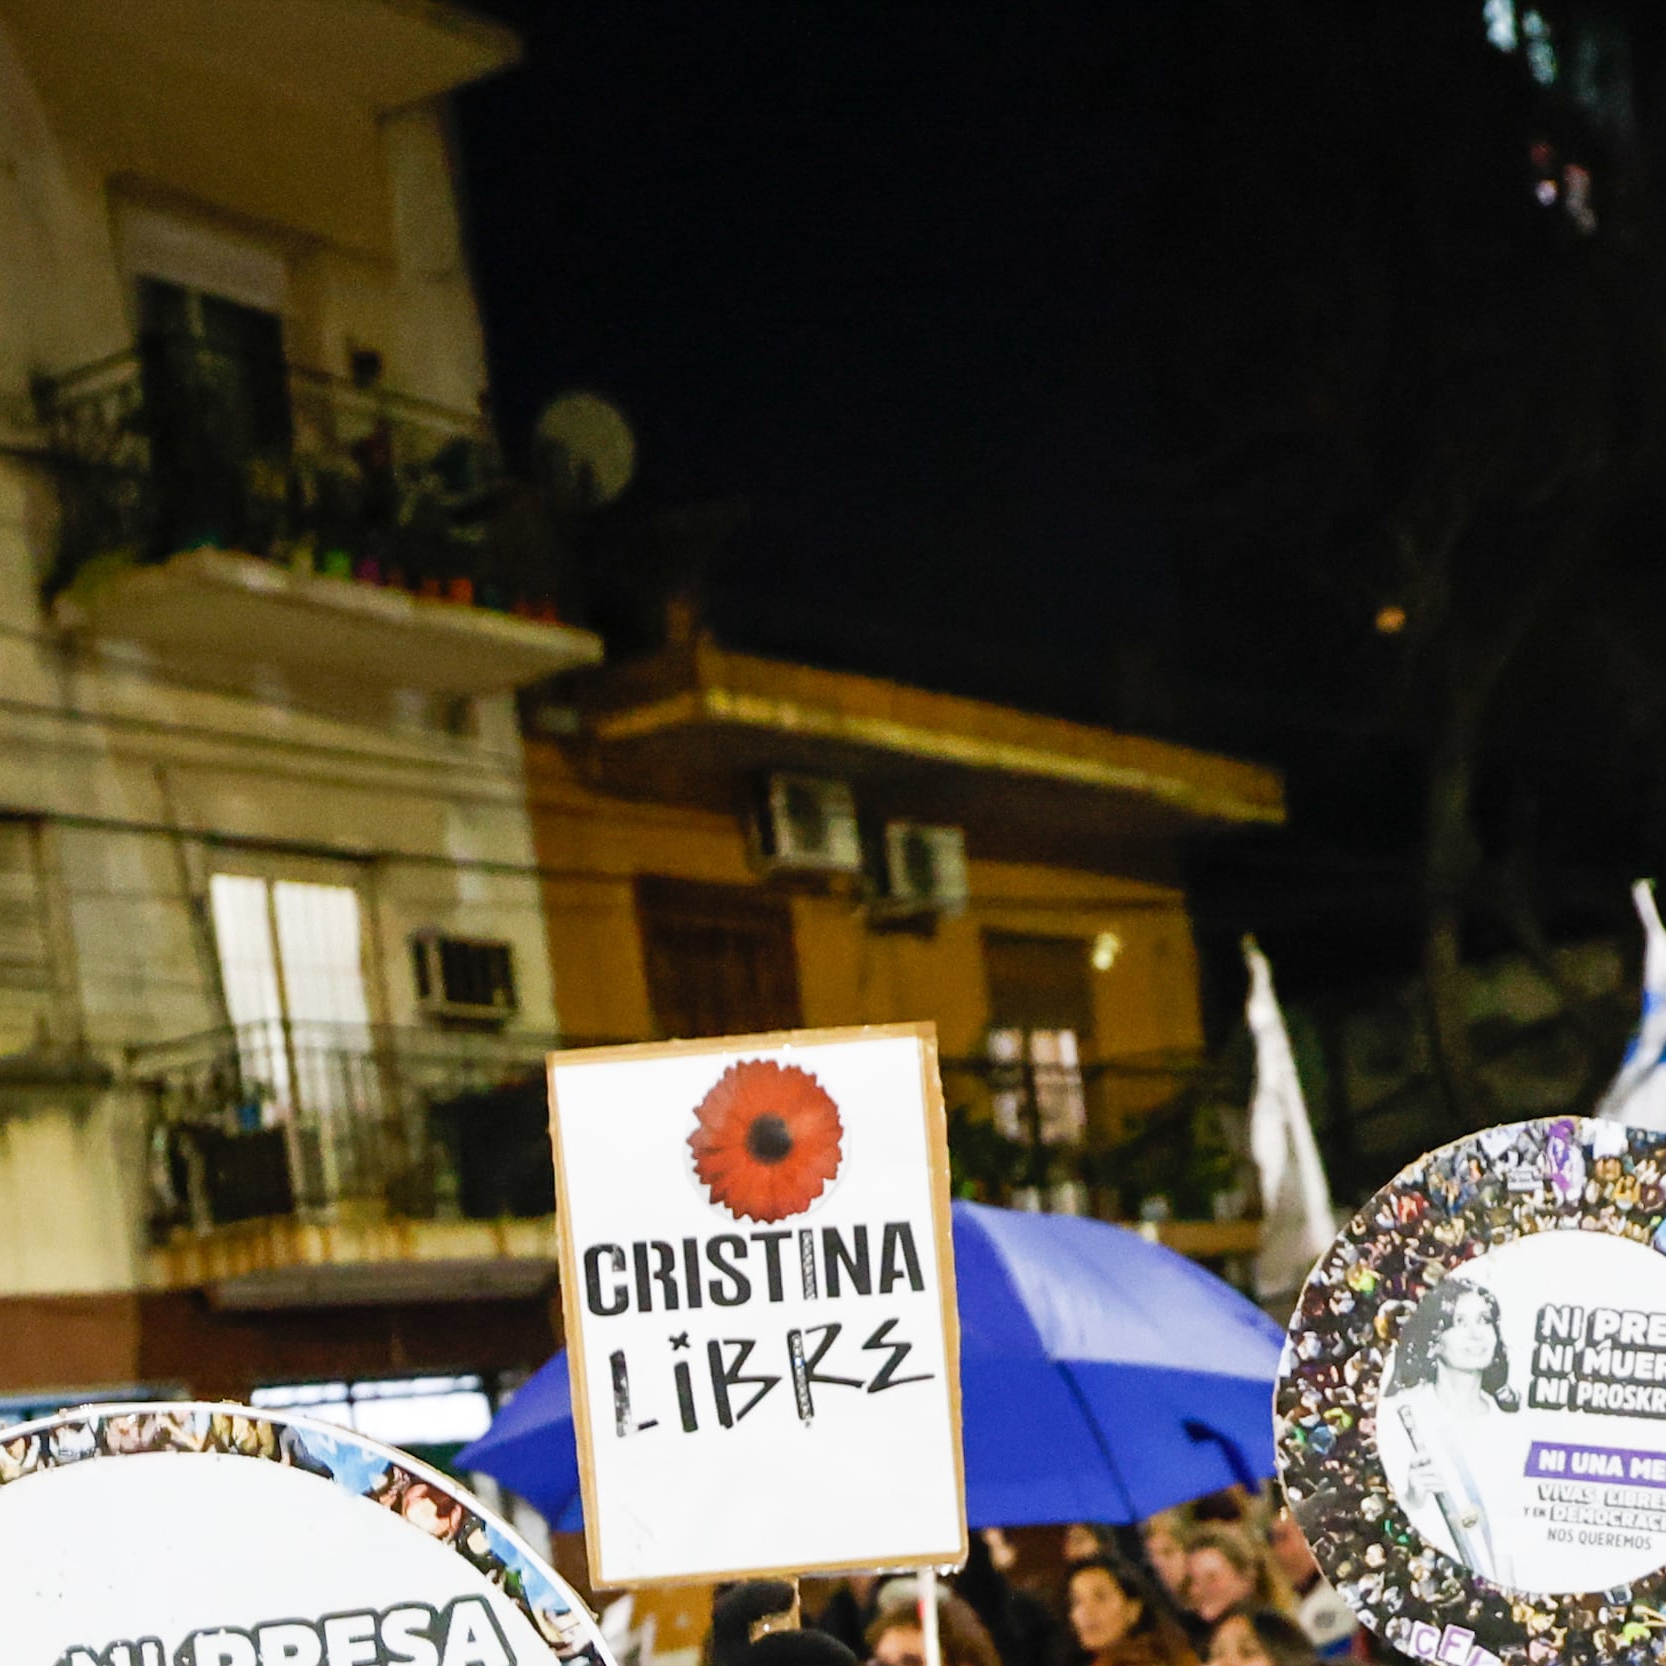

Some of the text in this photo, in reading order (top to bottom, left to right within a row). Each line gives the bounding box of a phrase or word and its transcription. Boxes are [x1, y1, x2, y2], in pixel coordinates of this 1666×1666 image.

[584, 1221, 925, 1316] CRISTINA
[1539, 1304, 1583, 1340] NI
[1535, 1343, 1573, 1375] NI
[1532, 1376, 1571, 1407] NI
[1538, 1449, 1566, 1473] NI
[1571, 1452, 1624, 1477] UNA
[1523, 1507, 1531, 1517] Y
[1532, 1508, 1546, 1518] EN
[1547, 1528, 1652, 1550] NOS QUEREMOS
